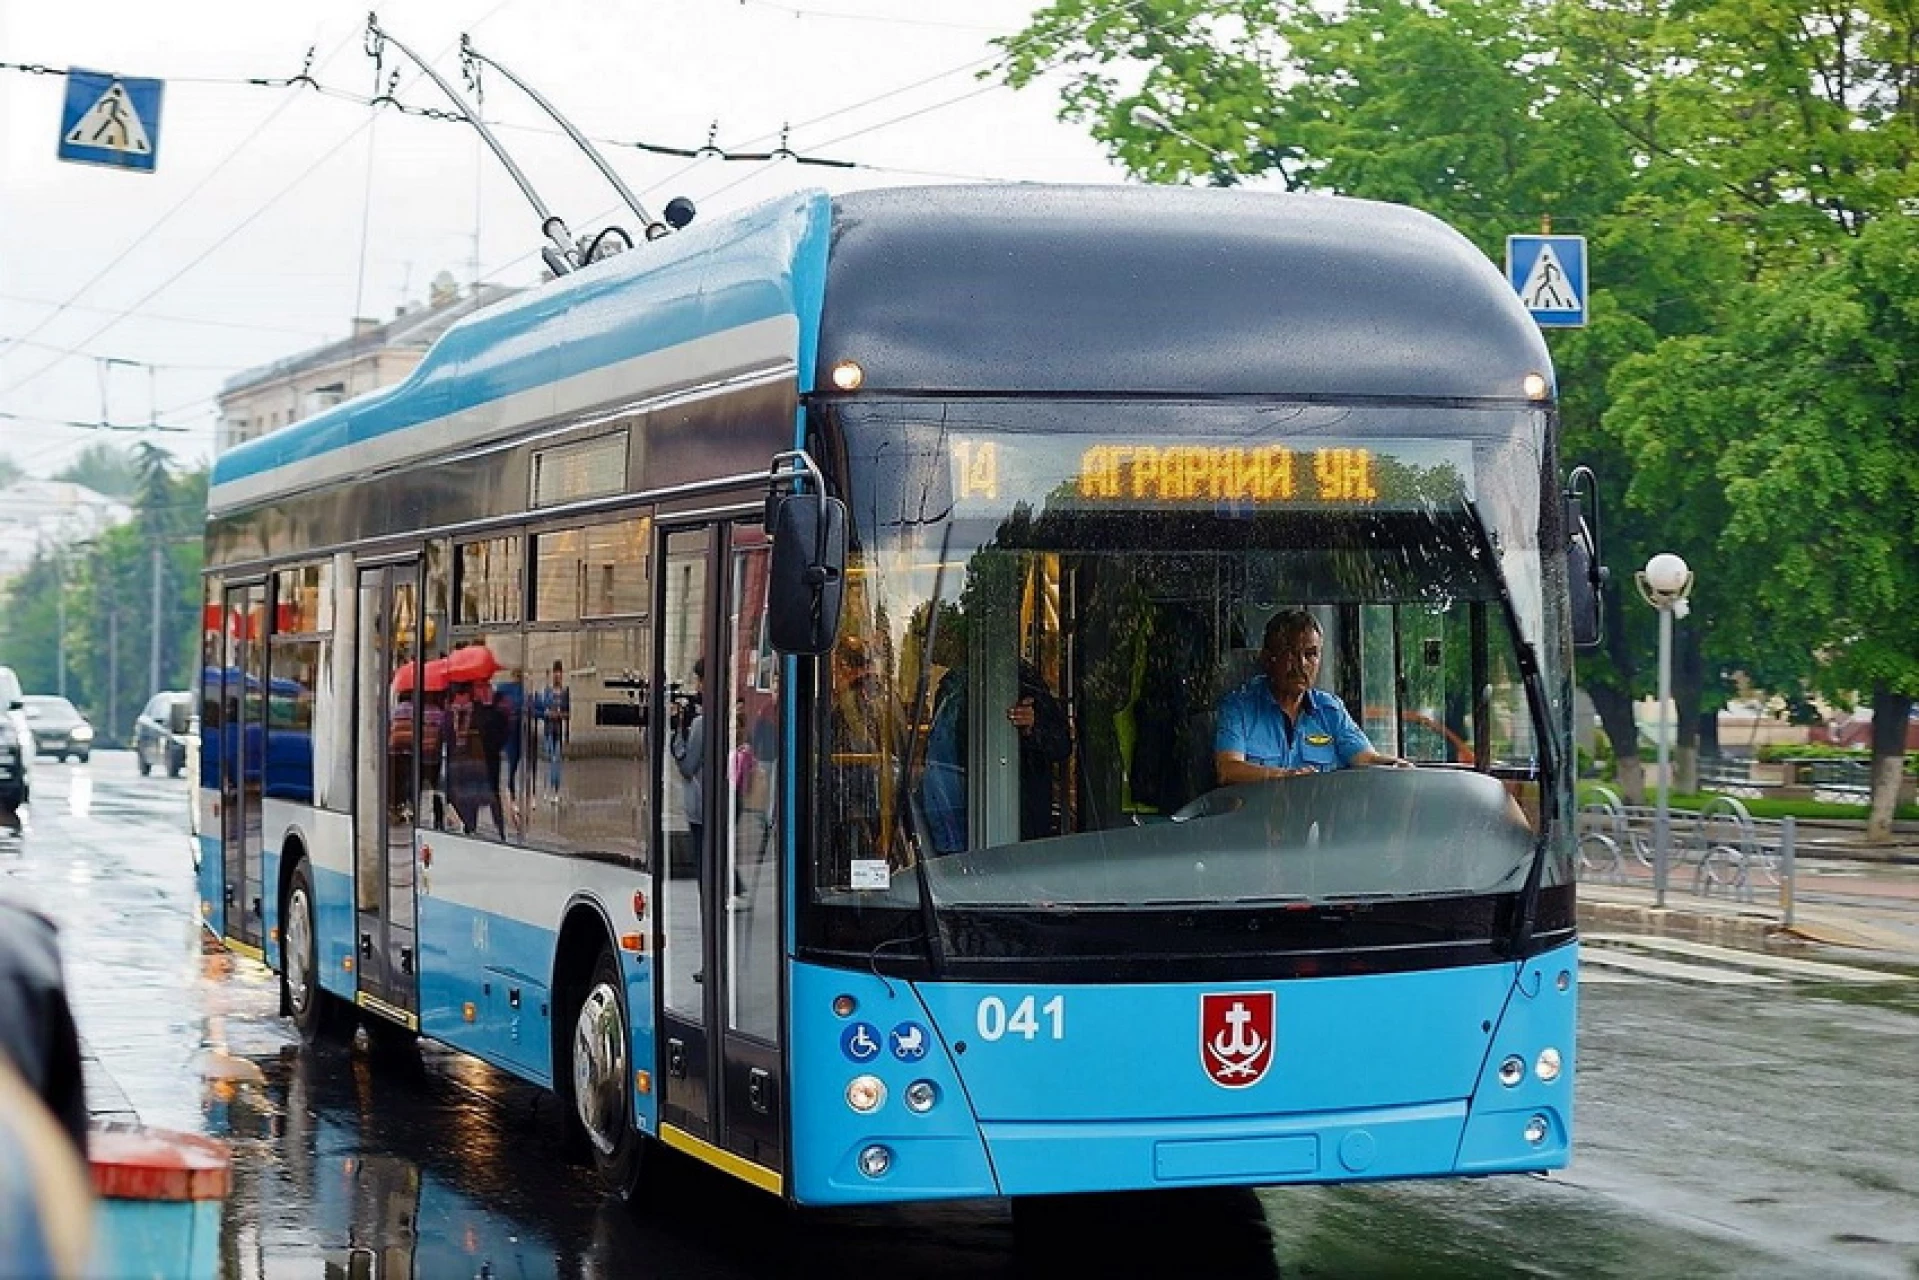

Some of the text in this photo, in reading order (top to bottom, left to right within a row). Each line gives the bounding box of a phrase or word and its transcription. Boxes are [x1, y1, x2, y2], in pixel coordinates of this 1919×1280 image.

[954, 441, 1376, 499] 14 АГРАРНИЙ УН.
[977, 995, 1064, 1041] 041
